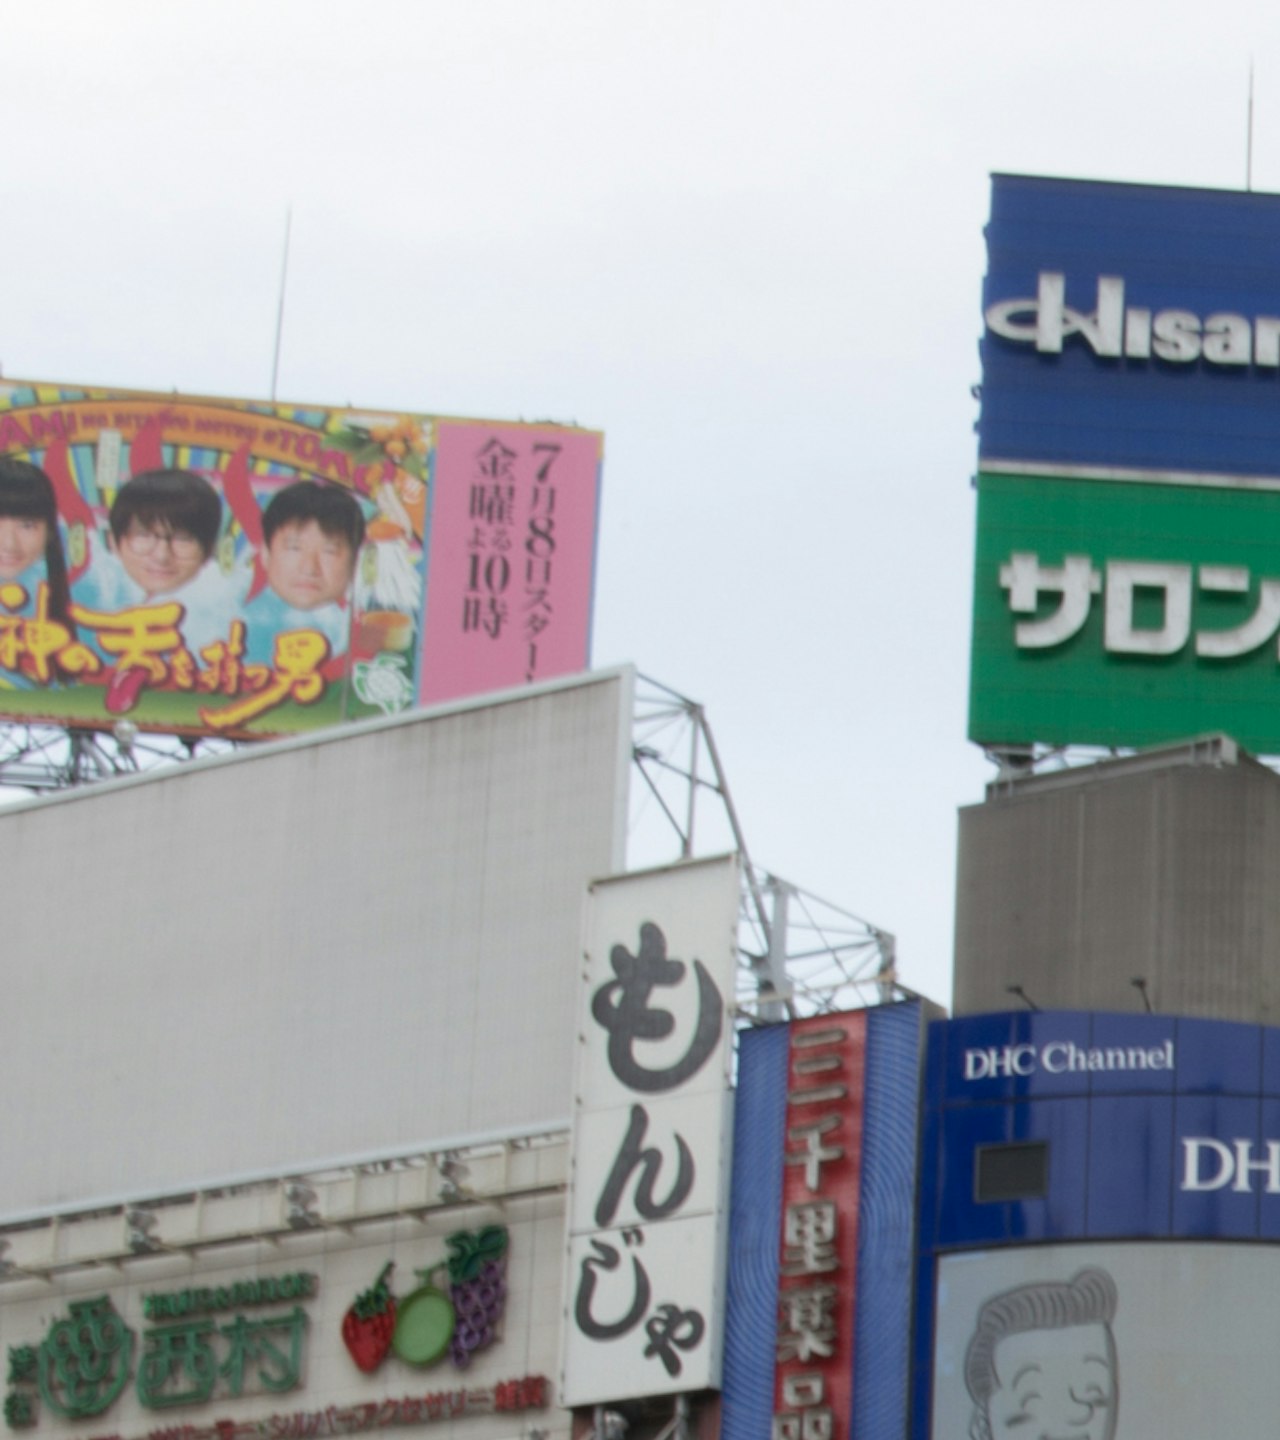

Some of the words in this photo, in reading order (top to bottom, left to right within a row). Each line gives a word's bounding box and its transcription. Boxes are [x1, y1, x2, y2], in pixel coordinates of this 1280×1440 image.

[463, 435, 518, 640] 金曜よる10時
[521, 440, 563, 684] 7月8日スター
[574, 920, 724, 1379] もんじゃ
[965, 1046, 1036, 1081] DHC
[1042, 1039, 1175, 1075] Channel
[137, 1305, 312, 1409] 西村
